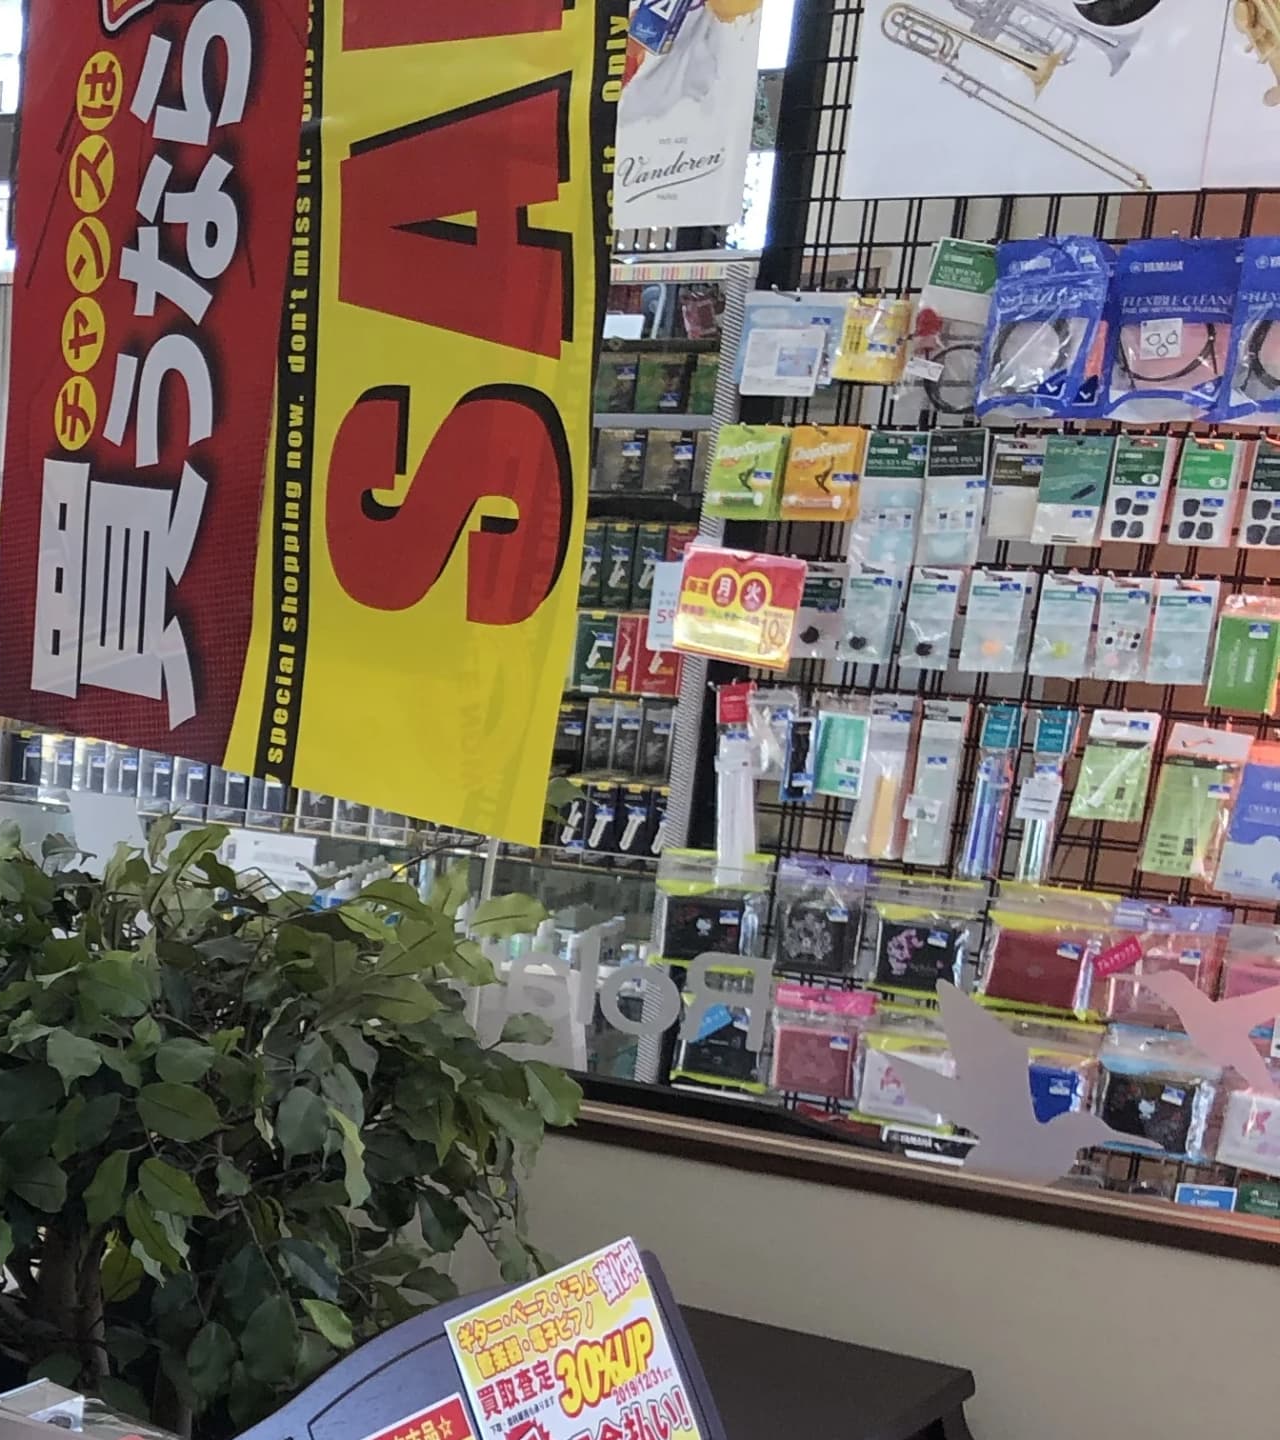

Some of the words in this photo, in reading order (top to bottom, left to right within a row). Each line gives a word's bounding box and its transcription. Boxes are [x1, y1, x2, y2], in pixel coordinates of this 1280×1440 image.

[601, 15, 629, 102] Only
[296, 148, 312, 184] it.
[617, 148, 724, 188] Vandoren
[54, 50, 124, 451] チャンスは
[291, 196, 311, 276] miss
[1143, 260, 1184, 273] YAMAHA
[31, 0, 253, 730] 買うなら
[287, 288, 308, 373] don't
[286, 394, 305, 469] now.
[280, 481, 302, 632] shopping
[743, 582, 762, 603] 火
[266, 642, 296, 764] special
[456, 1268, 599, 1354] ギター・ベース・ドラム
[474, 1301, 594, 1381] 管楽器・電子ピアノ
[476, 1359, 556, 1423] 買取査定
[554, 1316, 654, 1419] 30%UP
